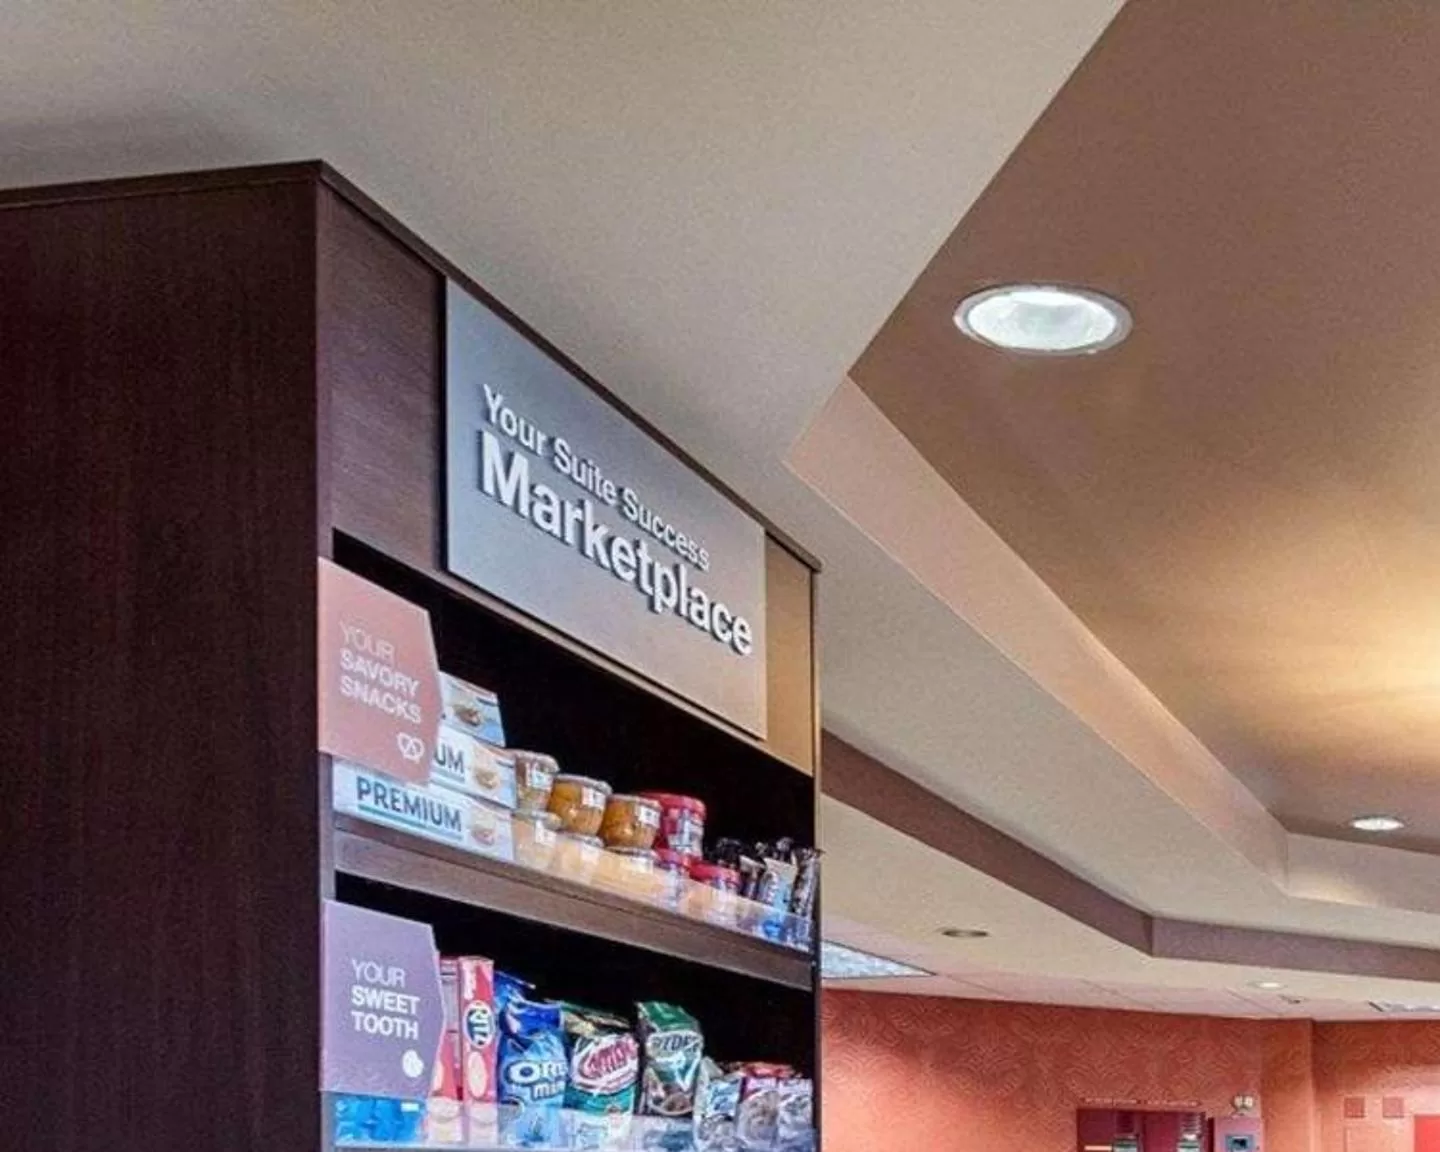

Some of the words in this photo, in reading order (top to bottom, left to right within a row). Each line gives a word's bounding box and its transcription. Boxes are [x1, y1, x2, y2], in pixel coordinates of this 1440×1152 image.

[483, 383, 549, 456] Your
[552, 436, 618, 506] Suite
[622, 487, 710, 572] Success
[479, 429, 754, 656] Marketplace
[340, 621, 395, 660] YOUR
[340, 649, 420, 697] SAVORY
[340, 676, 421, 724] SNACKS
[356, 776, 462, 833] PREMIUM
[351, 958, 406, 988] YOUR
[351, 985, 420, 1016] SWEET
[351, 1010, 419, 1040] TOOTH
